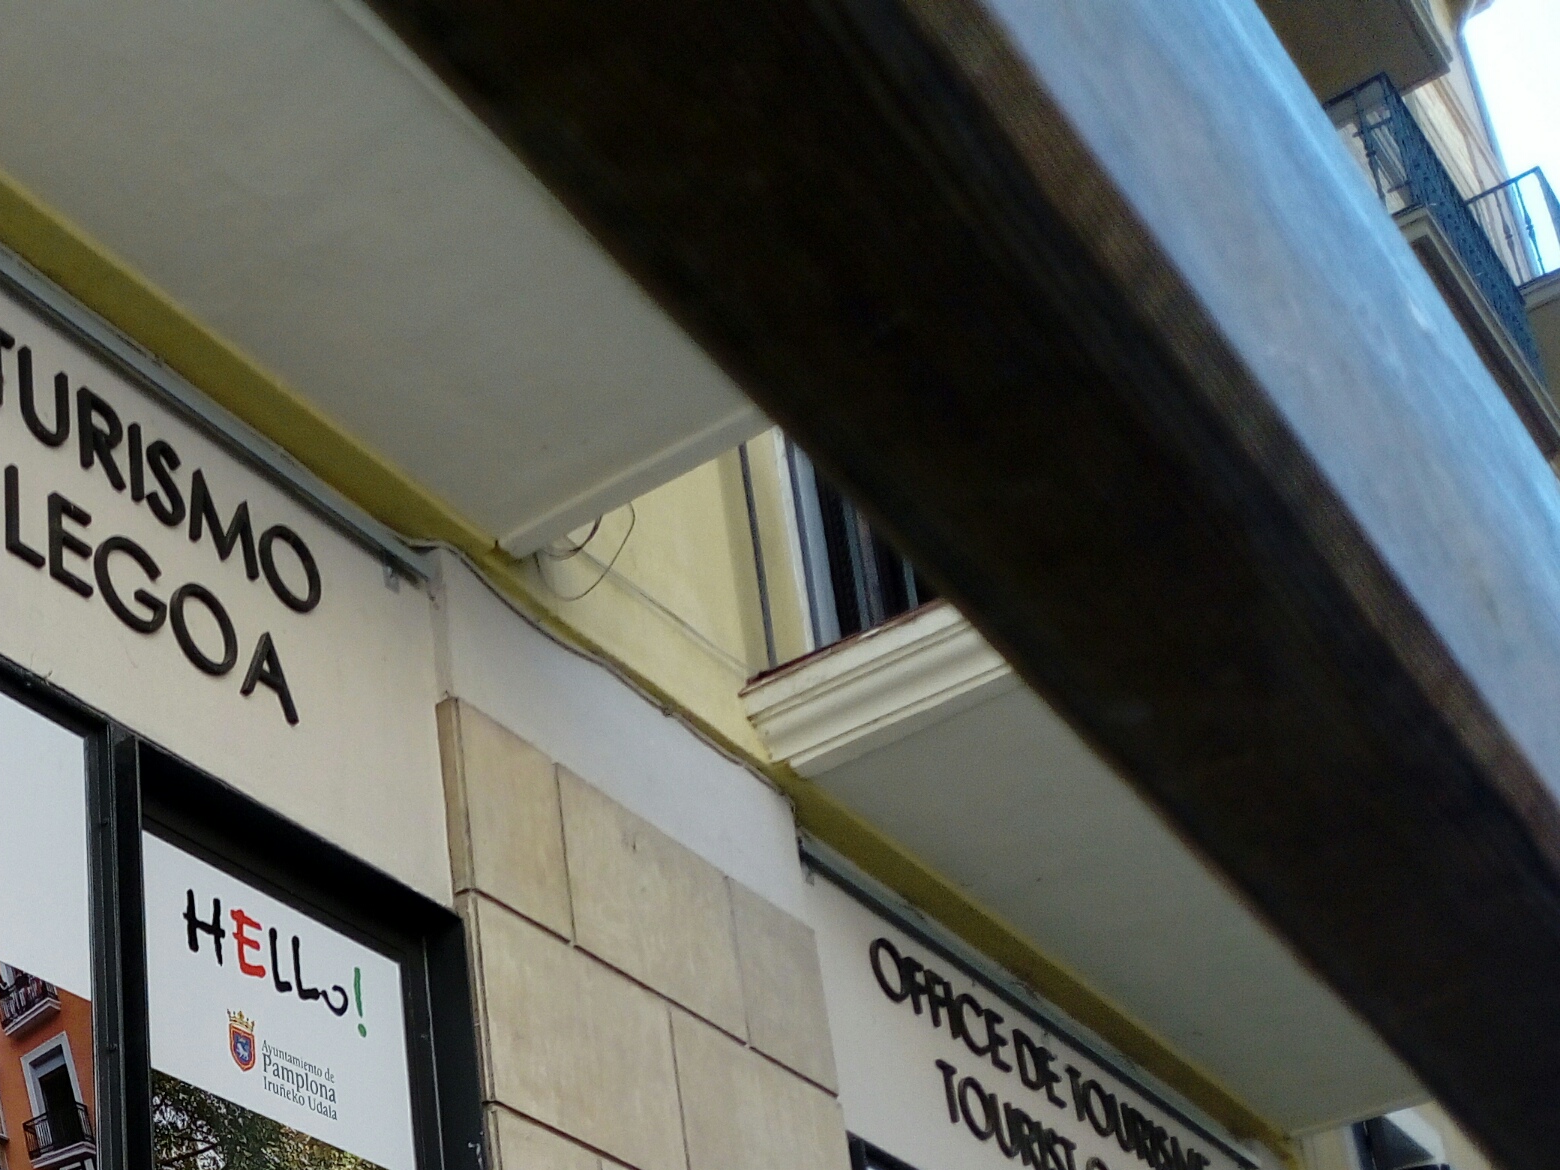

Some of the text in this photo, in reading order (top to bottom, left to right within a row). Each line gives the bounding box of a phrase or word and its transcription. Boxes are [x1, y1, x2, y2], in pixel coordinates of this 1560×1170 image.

[182, 888, 368, 1039] HELLO!
[869, 937, 1013, 1073] OFFICE
[1012, 1028, 1068, 1109] DE
[261, 1039, 336, 1084] Ayuntamiento de
[262, 1053, 337, 1104] Pamplona
[262, 1075, 338, 1121] Iruñeko Udala
